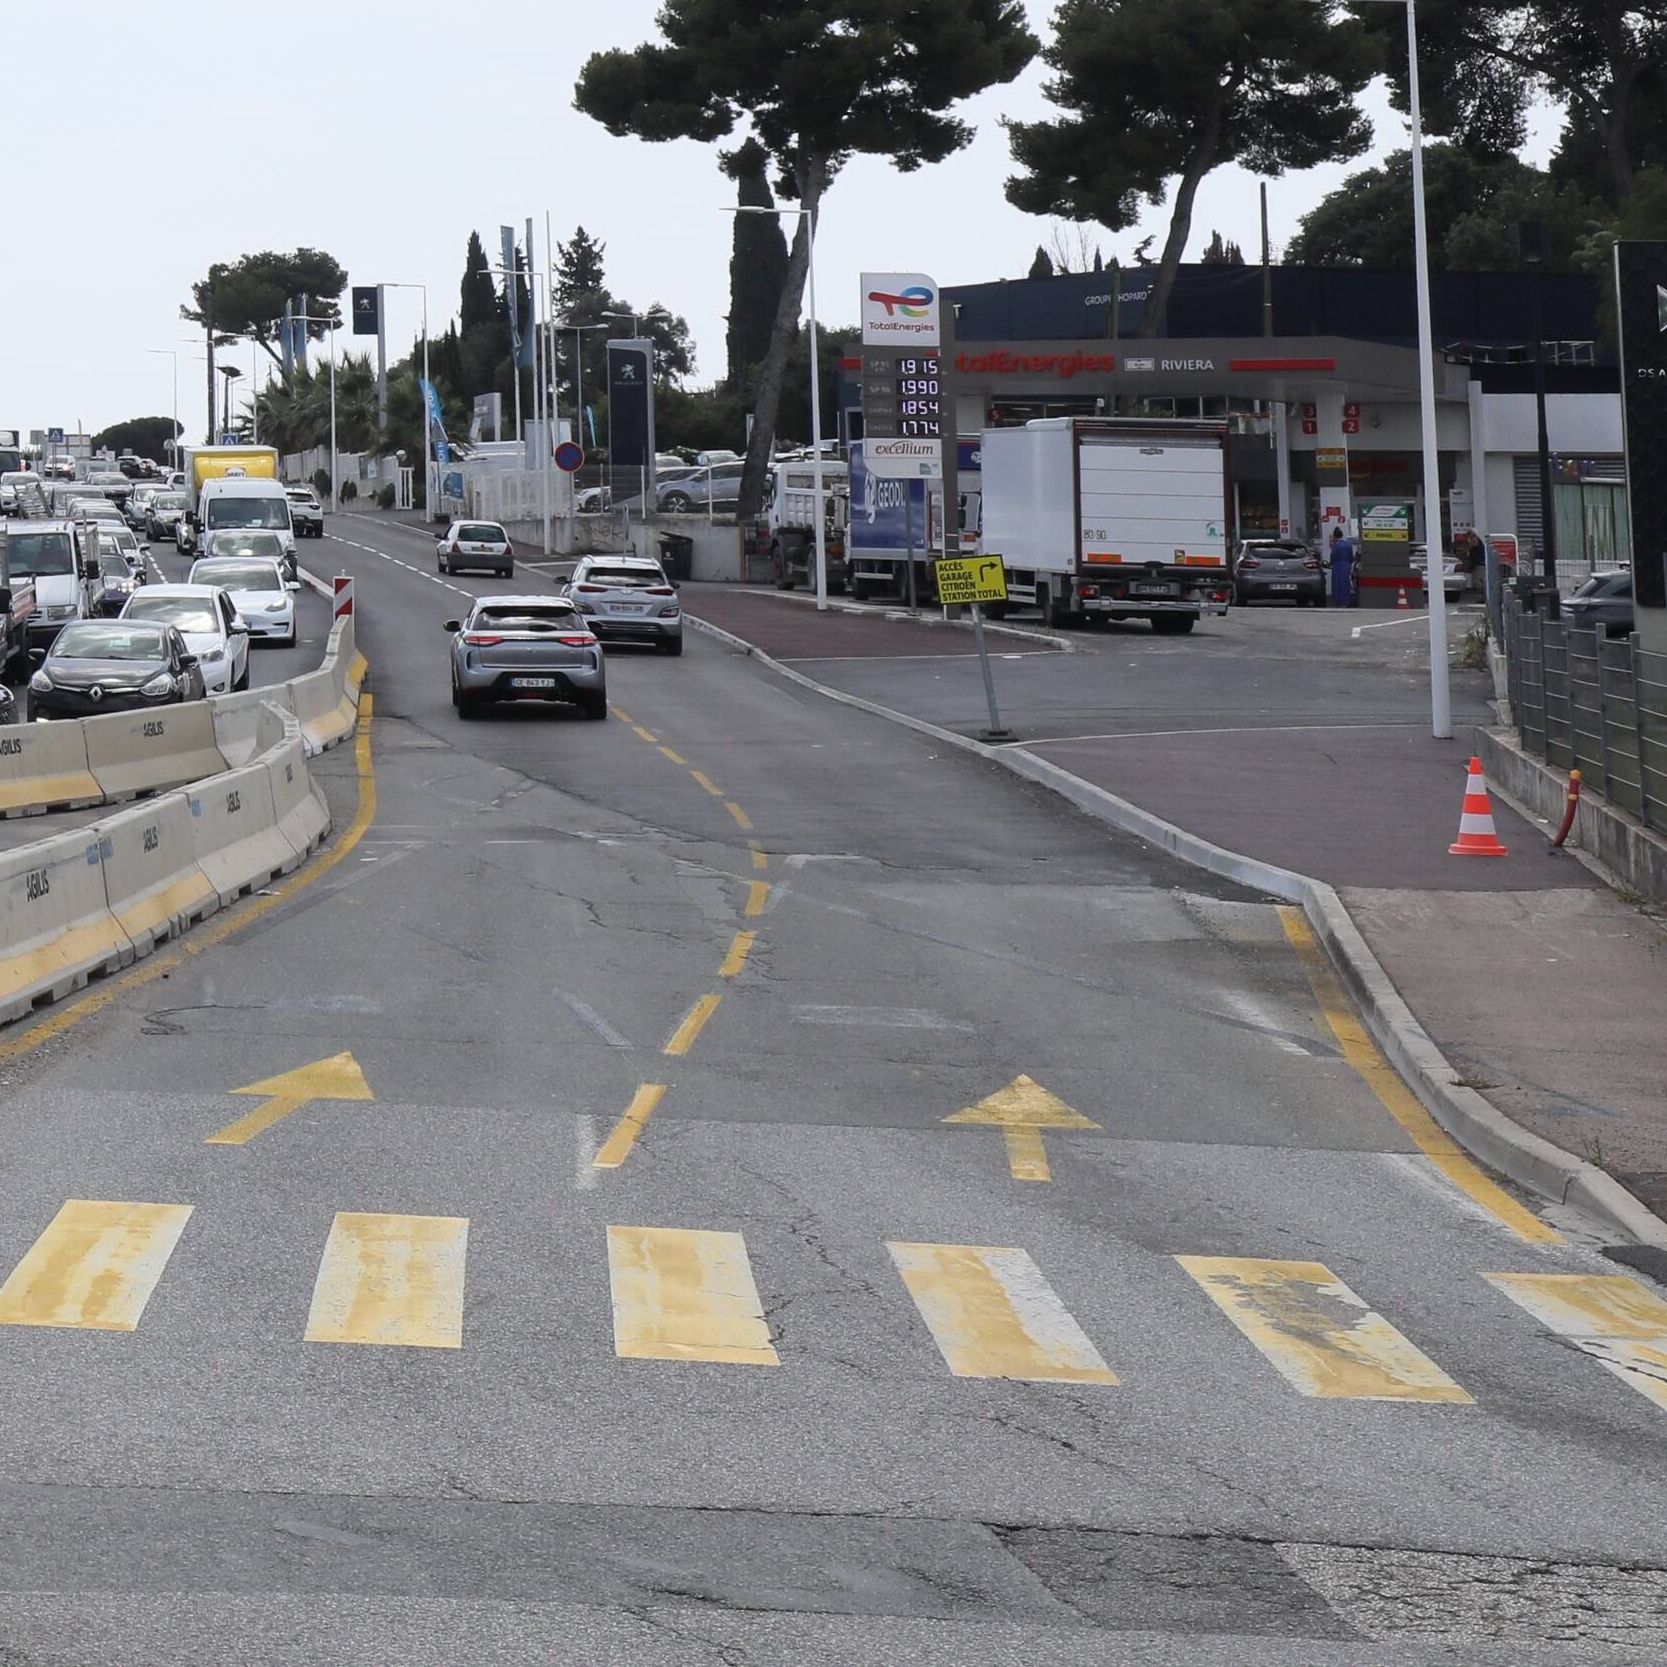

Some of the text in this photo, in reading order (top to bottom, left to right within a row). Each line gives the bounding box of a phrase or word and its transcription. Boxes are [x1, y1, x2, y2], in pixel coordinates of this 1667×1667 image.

[869, 322, 935, 333] TotalEnergies
[956, 349, 1115, 377] talEnergies
[1161, 359, 1214, 371] RIVIERA
[875, 441, 933, 455] excellium
[940, 571, 973, 582] GARAGE
[942, 589, 1004, 602] STATION TOTAL
[143, 721, 163, 737] AGILIS
[27, 869, 49, 902] AGILIS
